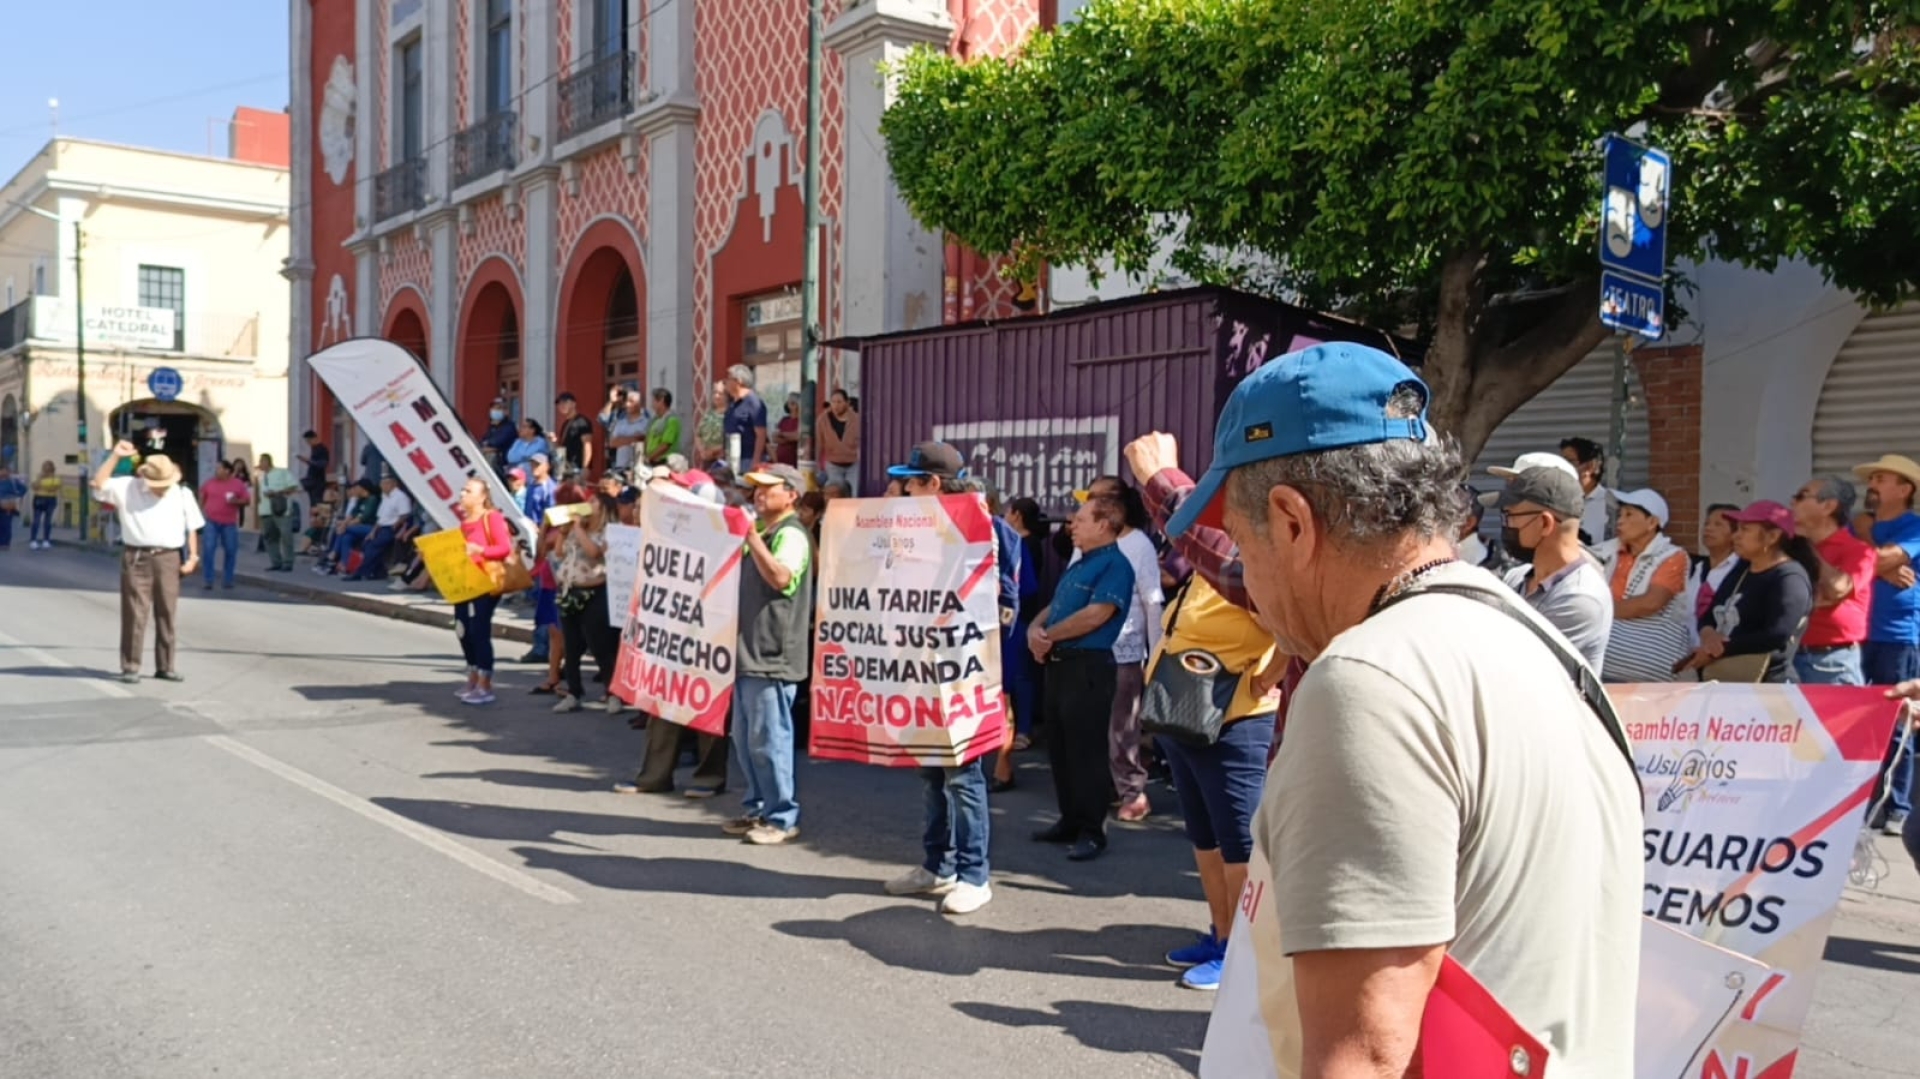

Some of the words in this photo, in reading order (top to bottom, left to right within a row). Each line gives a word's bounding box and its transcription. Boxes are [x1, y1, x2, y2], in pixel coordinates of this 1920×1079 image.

[85, 317, 169, 336] CATEDRAL
[101, 306, 154, 321] HOTEL
[388, 420, 468, 523] ANUE
[411, 395, 534, 559] MOROS
[896, 514, 937, 528] Nacional
[643, 543, 680, 578] QUE
[683, 552, 705, 586] LA
[637, 583, 668, 616] UZ
[669, 591, 704, 628] SEA
[828, 587, 871, 611] UNA
[877, 588, 965, 614] TARIFA
[636, 622, 732, 675] DERECHO
[818, 621, 887, 646] SOCIAL
[895, 621, 985, 649] JUSTA
[823, 654, 849, 678] ES
[855, 655, 985, 685] DEMANDA
[814, 684, 1000, 728] NACIONAL
[1626, 716, 1700, 740] samblea
[1706, 716, 1803, 743] Nacional
[1643, 828, 1829, 879] SUARIOS
[1642, 883, 1786, 935] CEMOS
